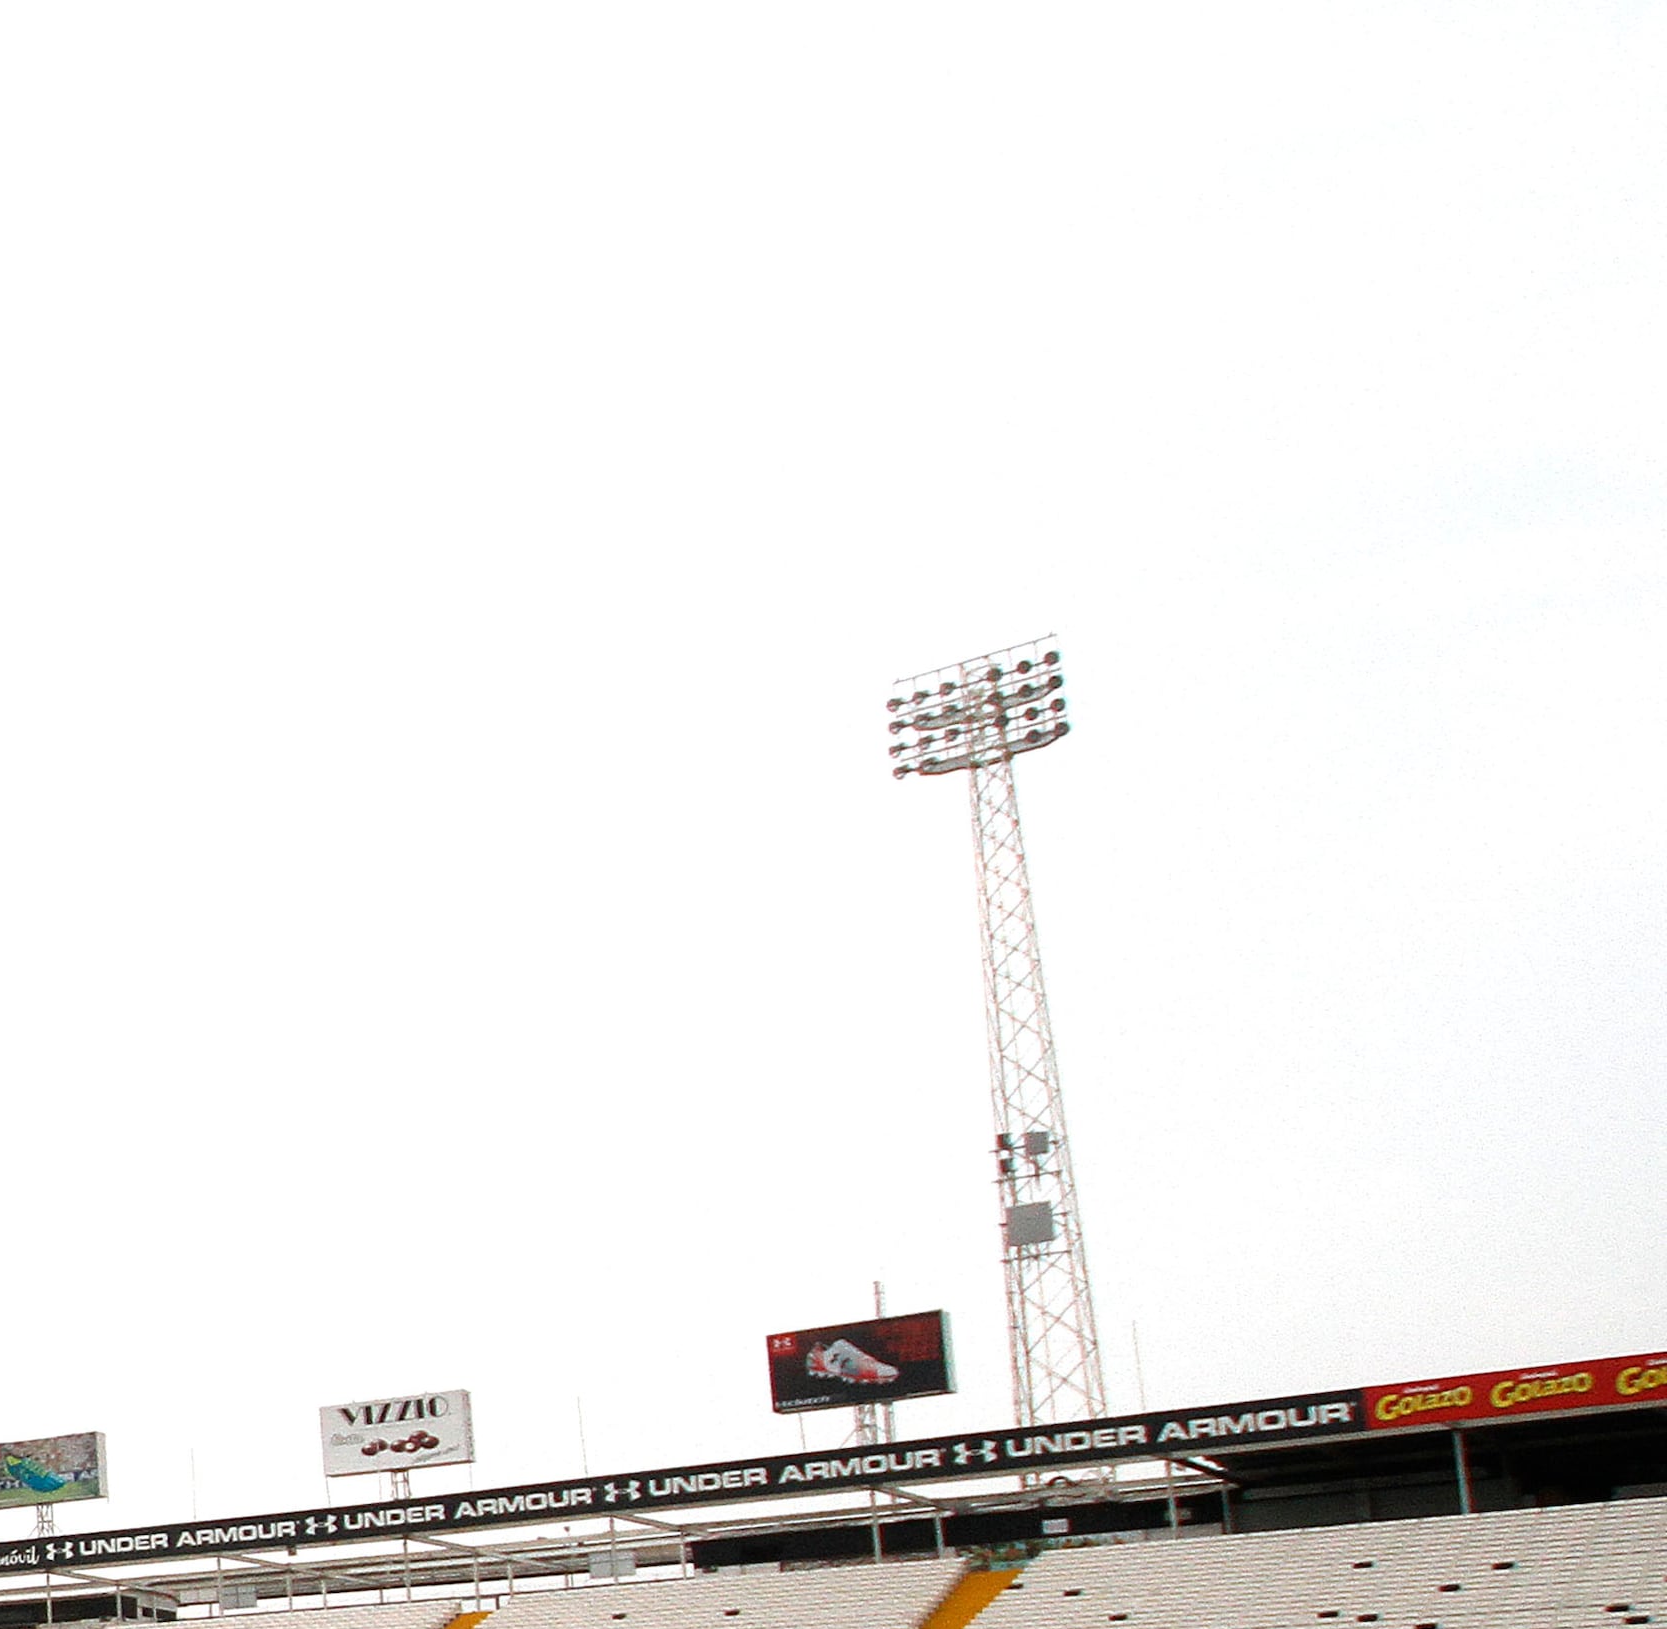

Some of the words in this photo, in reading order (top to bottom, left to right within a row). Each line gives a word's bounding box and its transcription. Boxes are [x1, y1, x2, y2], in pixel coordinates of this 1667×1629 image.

[337, 1395, 449, 1426] VIZZIO
[1005, 1424, 1147, 1458] UNDER
[1155, 1402, 1351, 1443] ARMOUR
[648, 1466, 768, 1497] UNDER
[778, 1448, 941, 1484] ARMOUR
[343, 1503, 445, 1530] UNDER
[454, 1487, 592, 1519] ARMOUR
[79, 1532, 169, 1556] UNDER
[176, 1521, 296, 1547] ARMOUR
